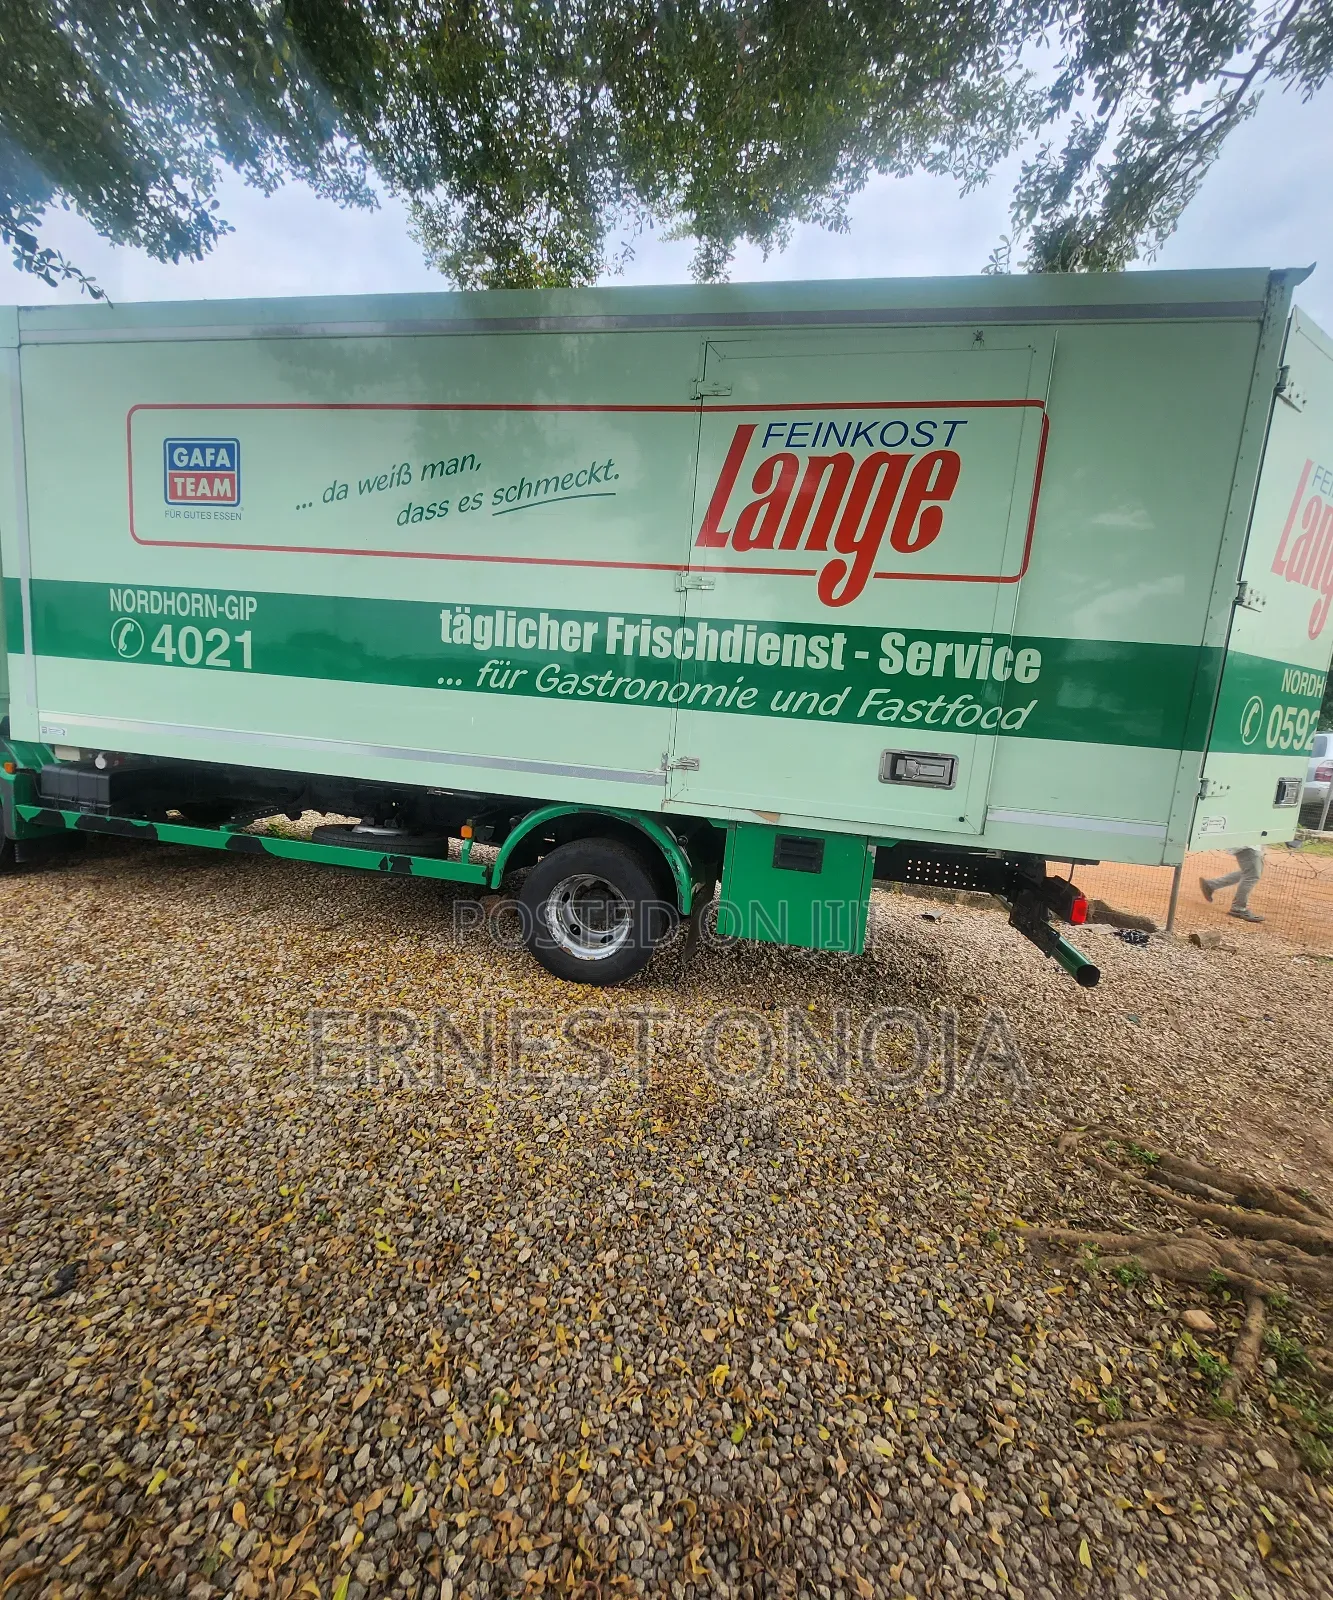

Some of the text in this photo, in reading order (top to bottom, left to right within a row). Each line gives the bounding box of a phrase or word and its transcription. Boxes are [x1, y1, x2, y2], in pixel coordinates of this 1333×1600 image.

[762, 420, 968, 448] FEINKOST
[173, 447, 231, 467] GAFA
[322, 480, 349, 504] da
[358, 463, 413, 496] weiß
[421, 453, 482, 482] man,
[174, 478, 232, 497] TEAM
[396, 458, 620, 526] dass es schmeckt.
[164, 509, 242, 521] FÜR GUTES ESSEN
[694, 423, 961, 608] Lange
[109, 588, 258, 621] NORDHORN-GIP
[151, 624, 252, 669] 4021
[440, 606, 599, 653] täglicher
[605, 616, 847, 670] Frischdienst
[878, 631, 1042, 684] Service
[476, 659, 528, 690] für
[534, 663, 759, 709] Gastronomie
[769, 686, 852, 717] und
[856, 687, 1039, 731] Fastfood
